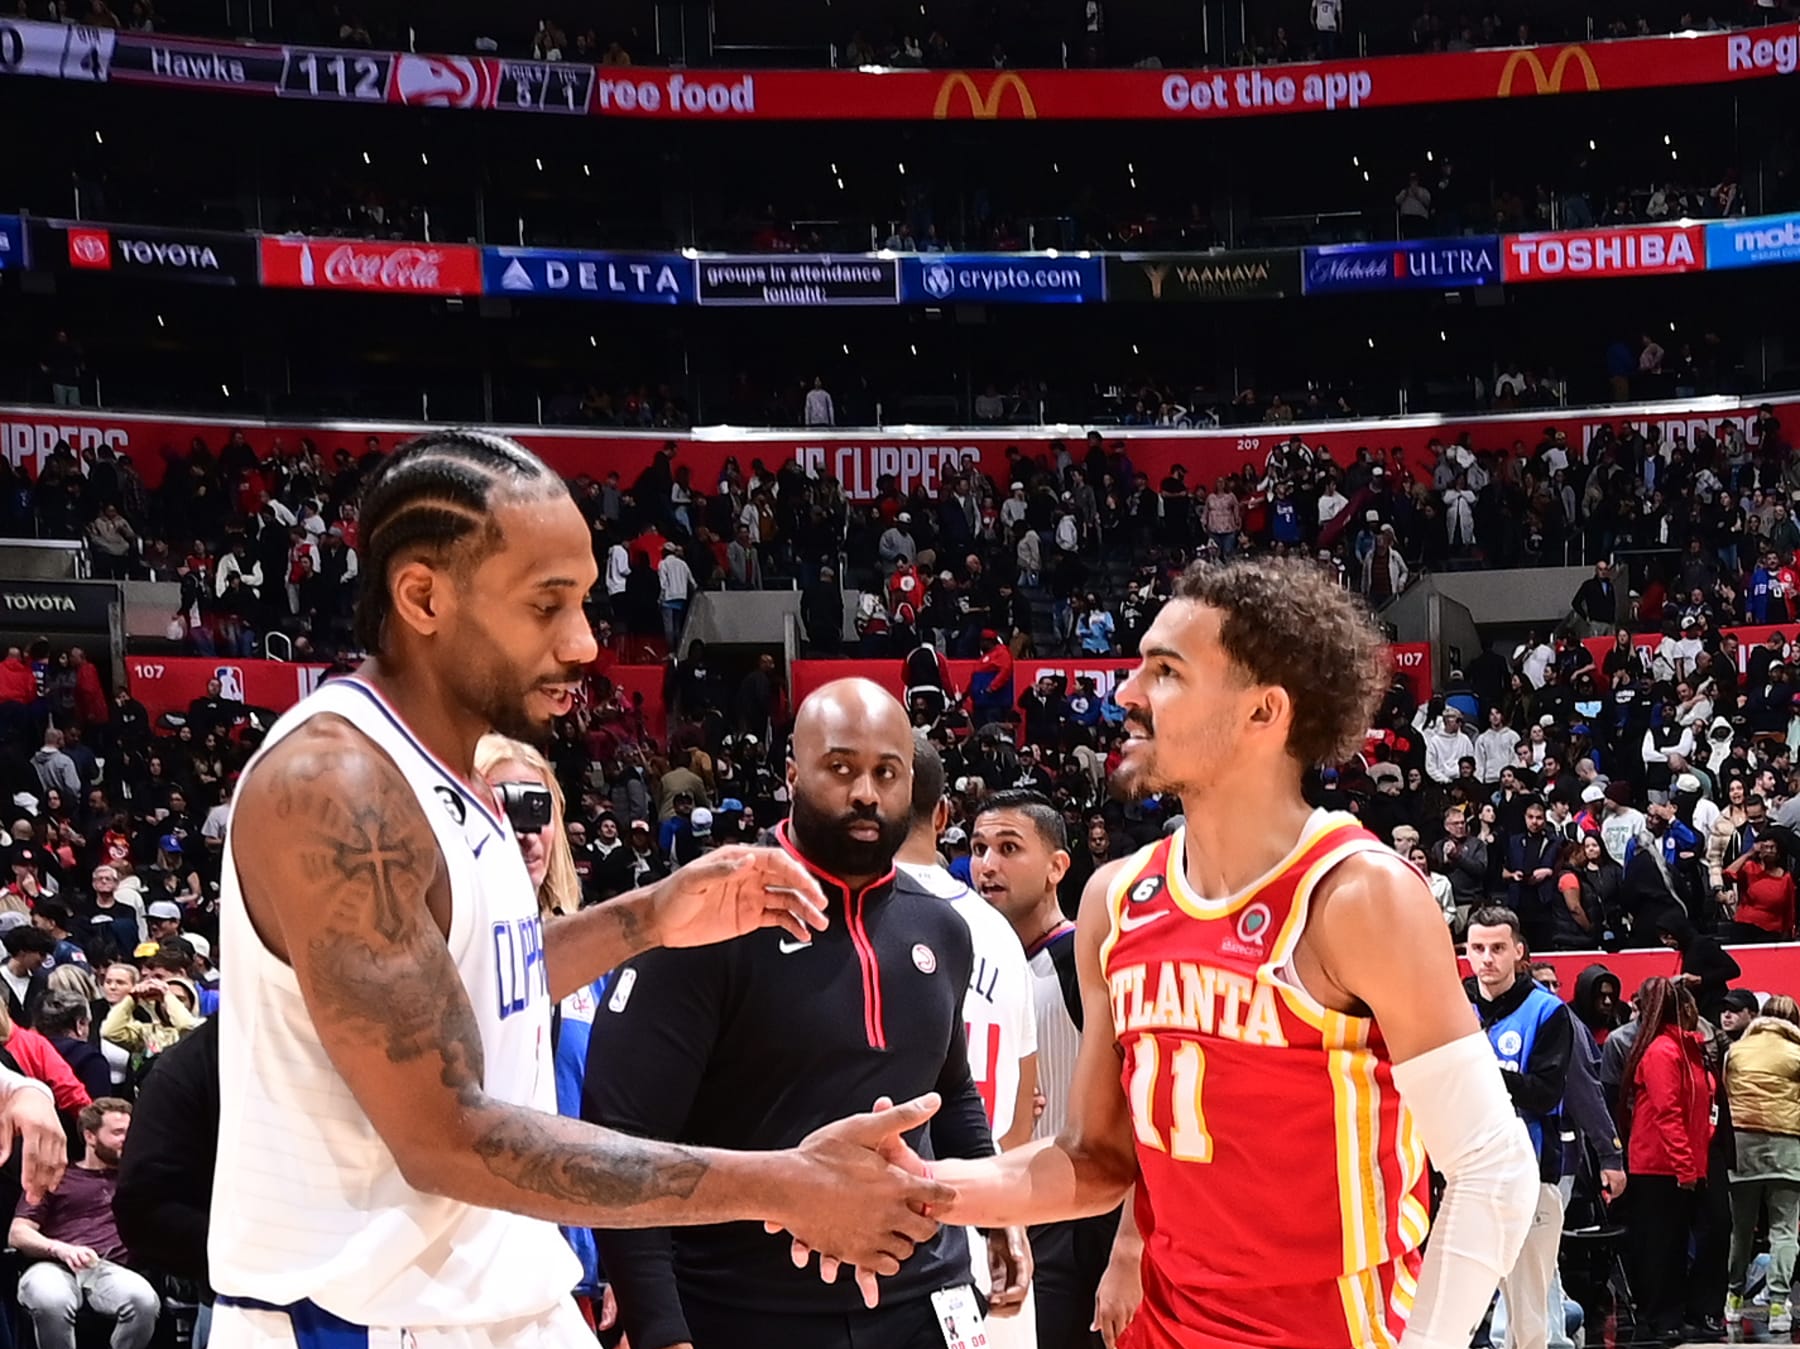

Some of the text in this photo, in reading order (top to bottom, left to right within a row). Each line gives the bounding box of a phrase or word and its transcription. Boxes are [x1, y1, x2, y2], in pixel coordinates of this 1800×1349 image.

[151, 45, 246, 84] Hawks
[1727, 34, 1797, 75] Reg
[299, 53, 381, 99] 112
[1161, 70, 1373, 111] Get the app
[561, 83, 574, 113] 1
[667, 73, 755, 113] food
[117, 238, 219, 270] TOYOTA
[1408, 248, 1494, 278] ULTRA
[1511, 232, 1696, 275] TOSHIBA
[545, 259, 680, 294] DELTA
[706, 264, 883, 288] groups in attendance
[958, 266, 1082, 292] crypto.com
[1237, 439, 1260, 451] 209
[3, 593, 77, 612] TOYOTA
[134, 664, 165, 680] 107
[1396, 652, 1424, 667] 107
[1131, 876, 1159, 902] 6
[1129, 1032, 1215, 1165] 11
